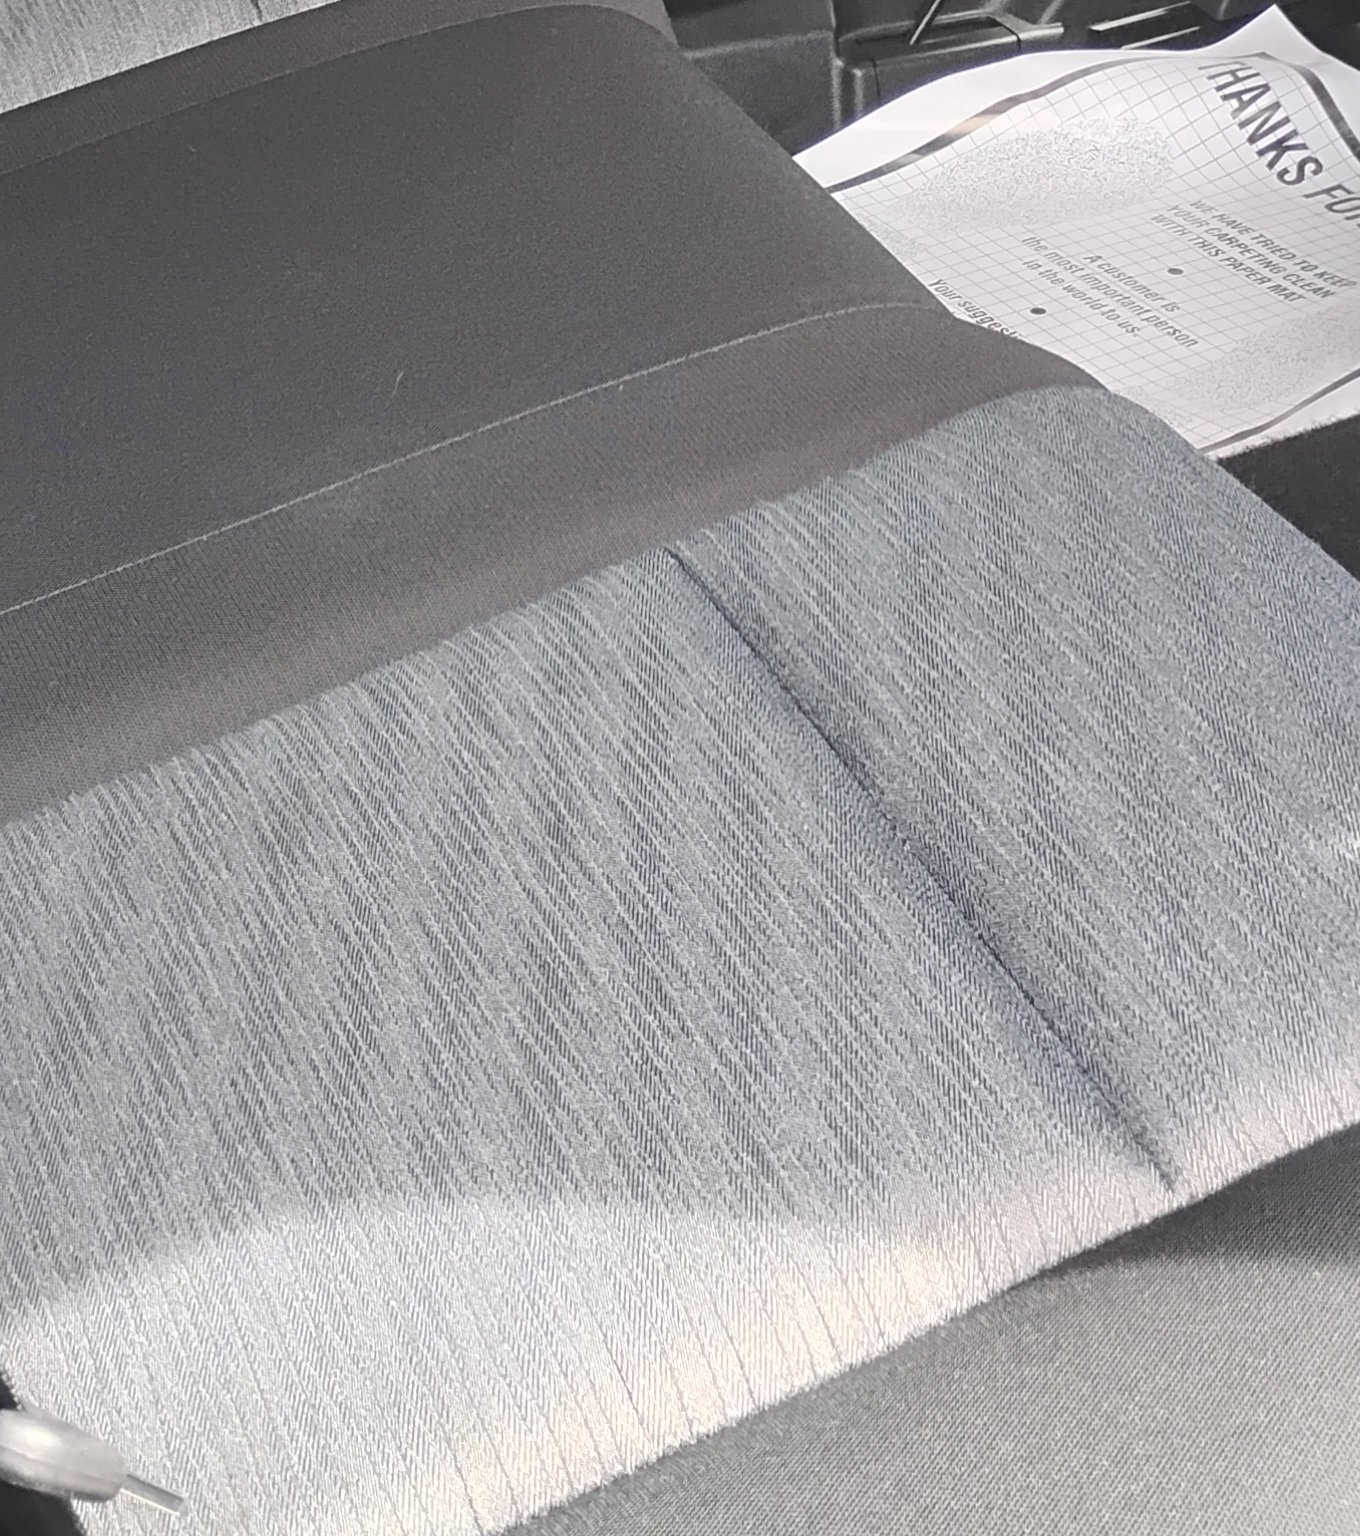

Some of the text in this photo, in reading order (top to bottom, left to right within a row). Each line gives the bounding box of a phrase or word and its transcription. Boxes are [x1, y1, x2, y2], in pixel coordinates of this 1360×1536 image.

[1197, 61, 1324, 188] THANKS
[1083, 255, 1181, 314] A customer is
[1150, 214, 1306, 303] WITH THIS PAPER MAT
[1166, 204, 1336, 299] YOUR CARPETING CLEAN
[1189, 200, 1358, 289] WE HAVE TRIED TO KEEP
[927, 278, 963, 302] Your
[1021, 236, 1200, 349] the most important person
[1022, 259, 1042, 274] in
[1038, 268, 1066, 286] the
[1061, 283, 1107, 312] world
[1100, 304, 1121, 322] to
